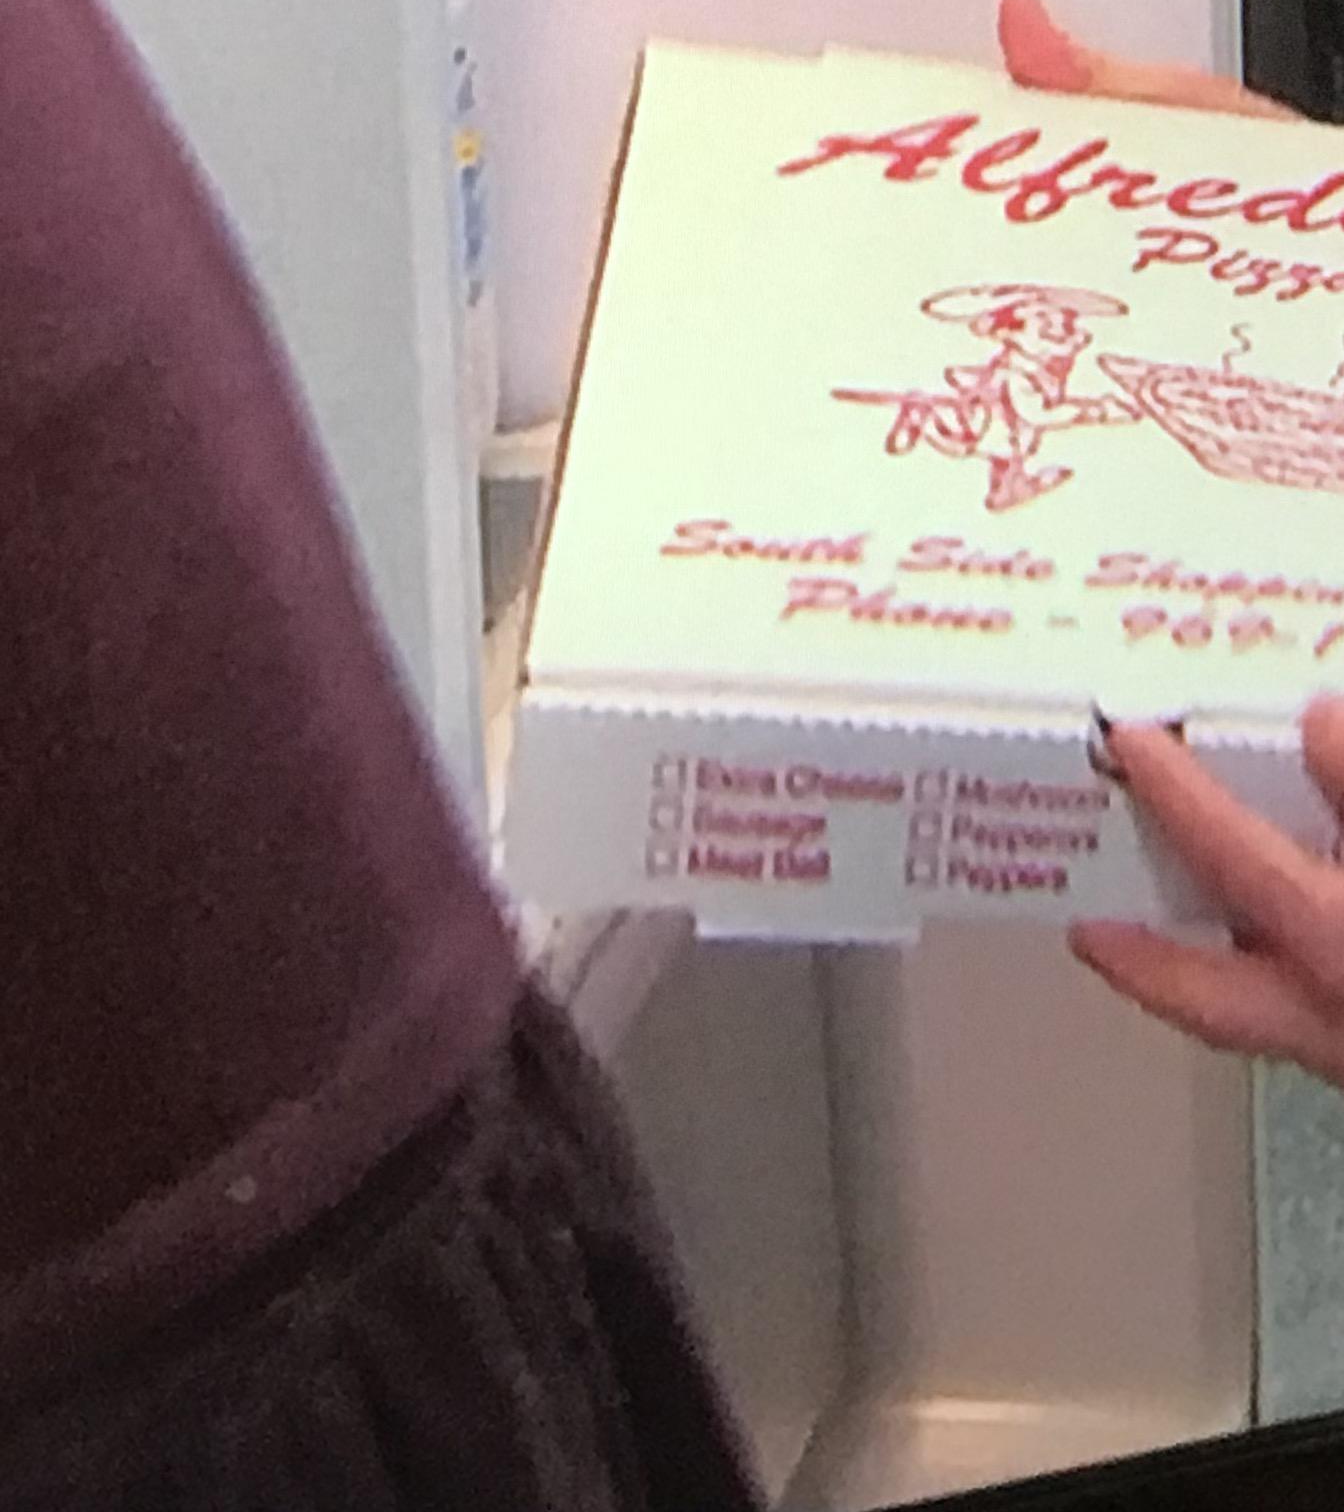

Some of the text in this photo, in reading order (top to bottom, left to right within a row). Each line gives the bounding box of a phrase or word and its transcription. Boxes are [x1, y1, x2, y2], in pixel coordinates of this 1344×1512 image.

[658, 520, 871, 564] South
[897, 536, 1055, 581] Side
[778, 576, 1014, 633] Phone
